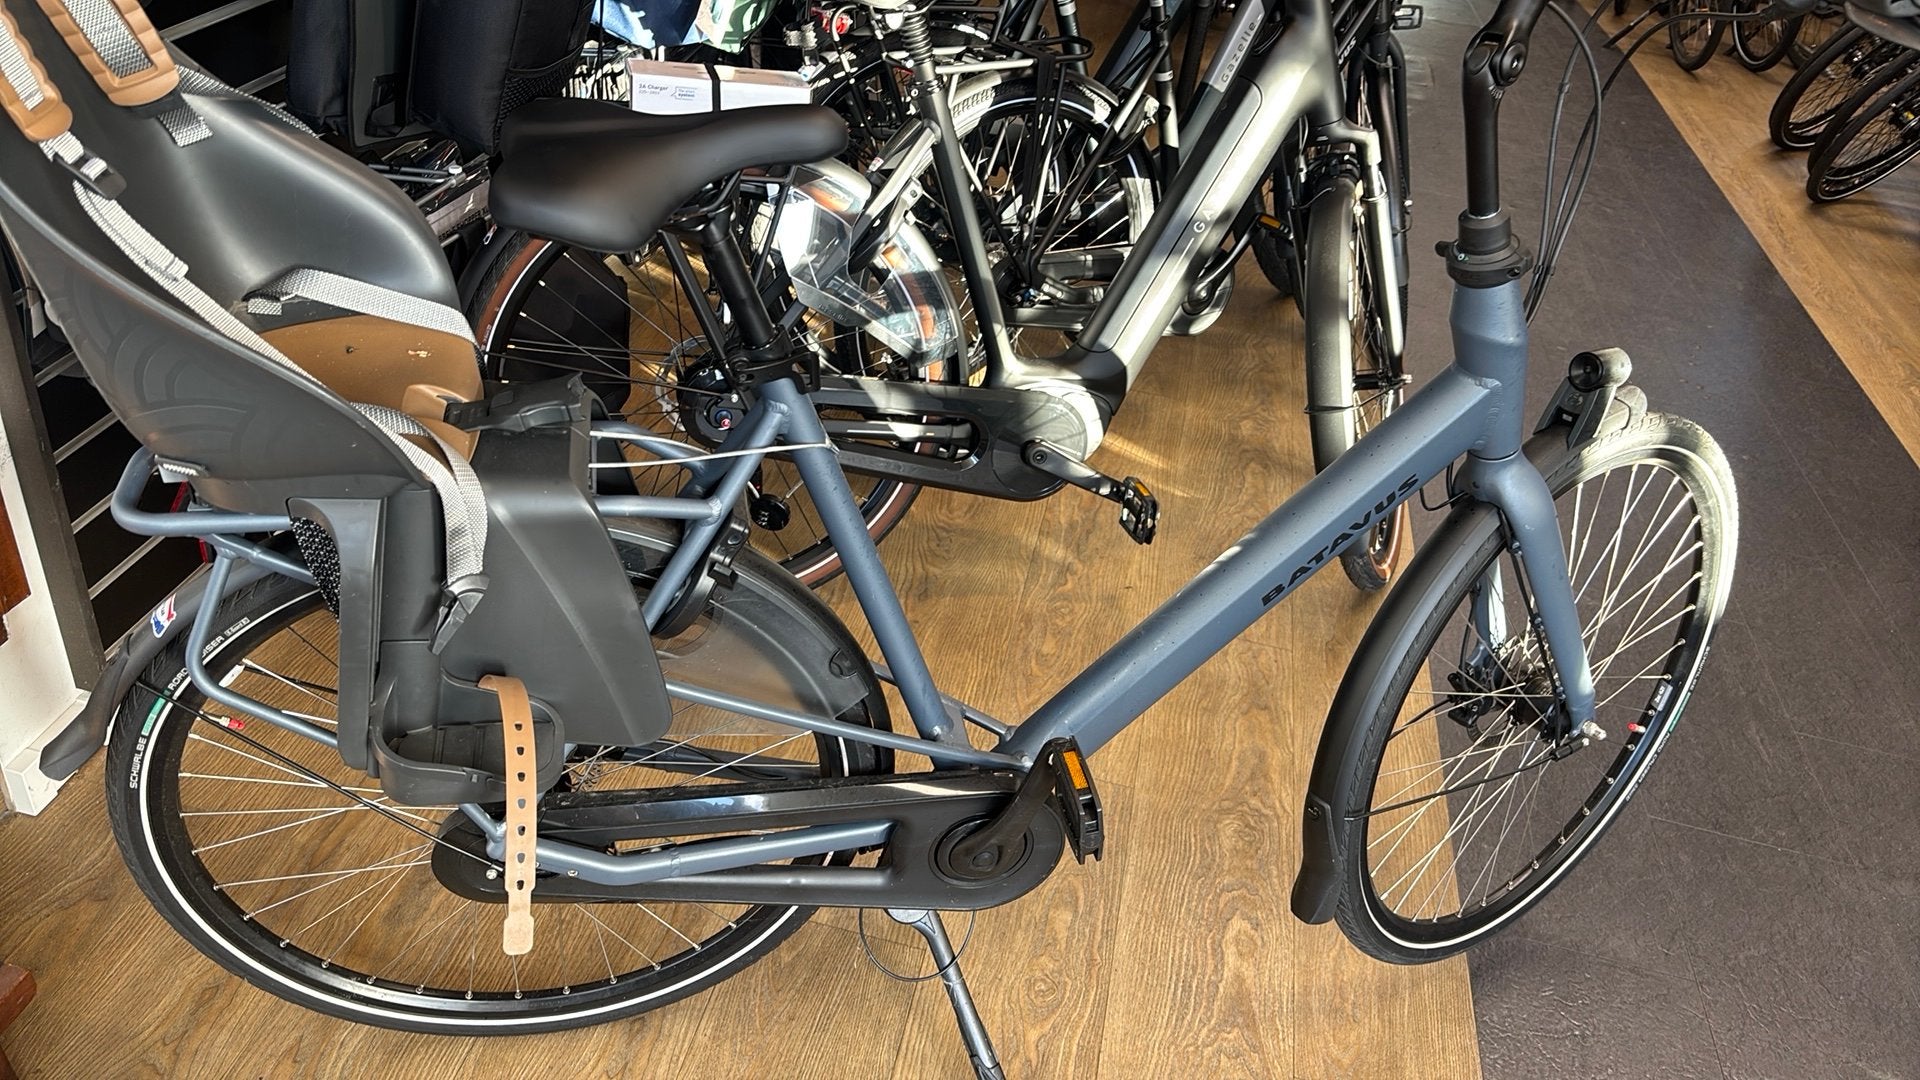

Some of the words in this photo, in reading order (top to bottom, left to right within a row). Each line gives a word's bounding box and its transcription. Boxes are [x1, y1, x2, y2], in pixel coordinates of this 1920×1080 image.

[1221, 22, 1257, 83] Gazelle
[1261, 473, 1419, 607] BATAVUS
[129, 736, 147, 790] SCHWALBE
[167, 667, 189, 691] ROAD
